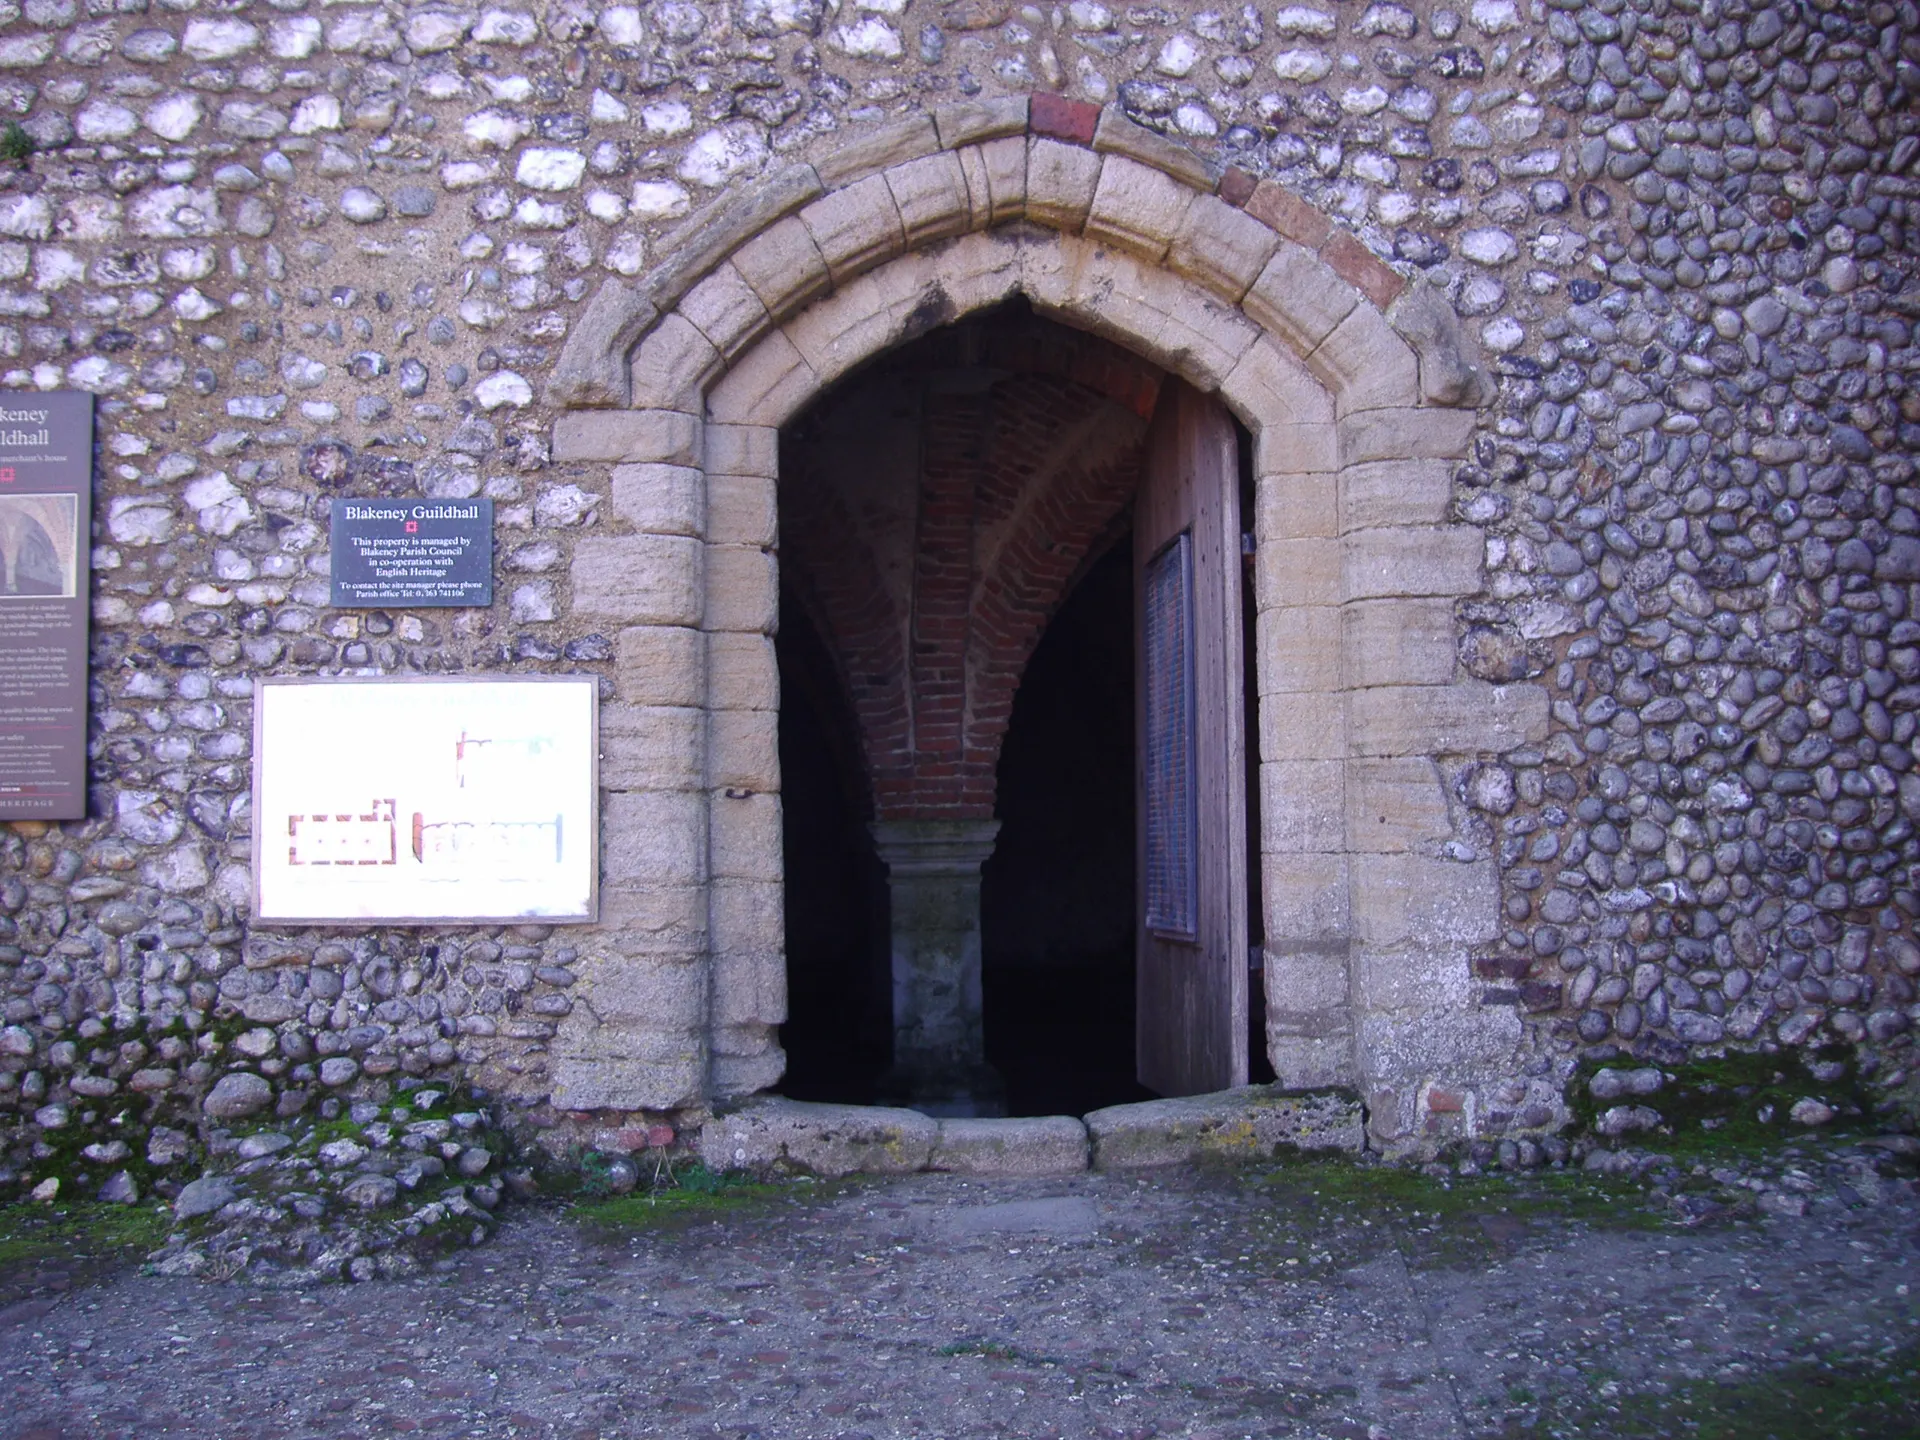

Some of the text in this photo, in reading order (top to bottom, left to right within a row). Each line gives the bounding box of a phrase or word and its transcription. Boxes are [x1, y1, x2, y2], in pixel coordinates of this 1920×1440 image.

[345, 505, 479, 521] Blakeney Guildhall
[351, 537, 471, 547] This property is managed by
[360, 547, 463, 557] Blakeney Parish Council
[369, 557, 454, 567] in co-operation with
[376, 567, 447, 578] English Heritage
[379, 581, 390, 589] the
[391, 581, 404, 589] site
[405, 582, 436, 590] manager
[437, 581, 459, 590] please
[460, 581, 483, 590] phone
[356, 590, 379, 598] Parish
[380, 589, 400, 597] office
